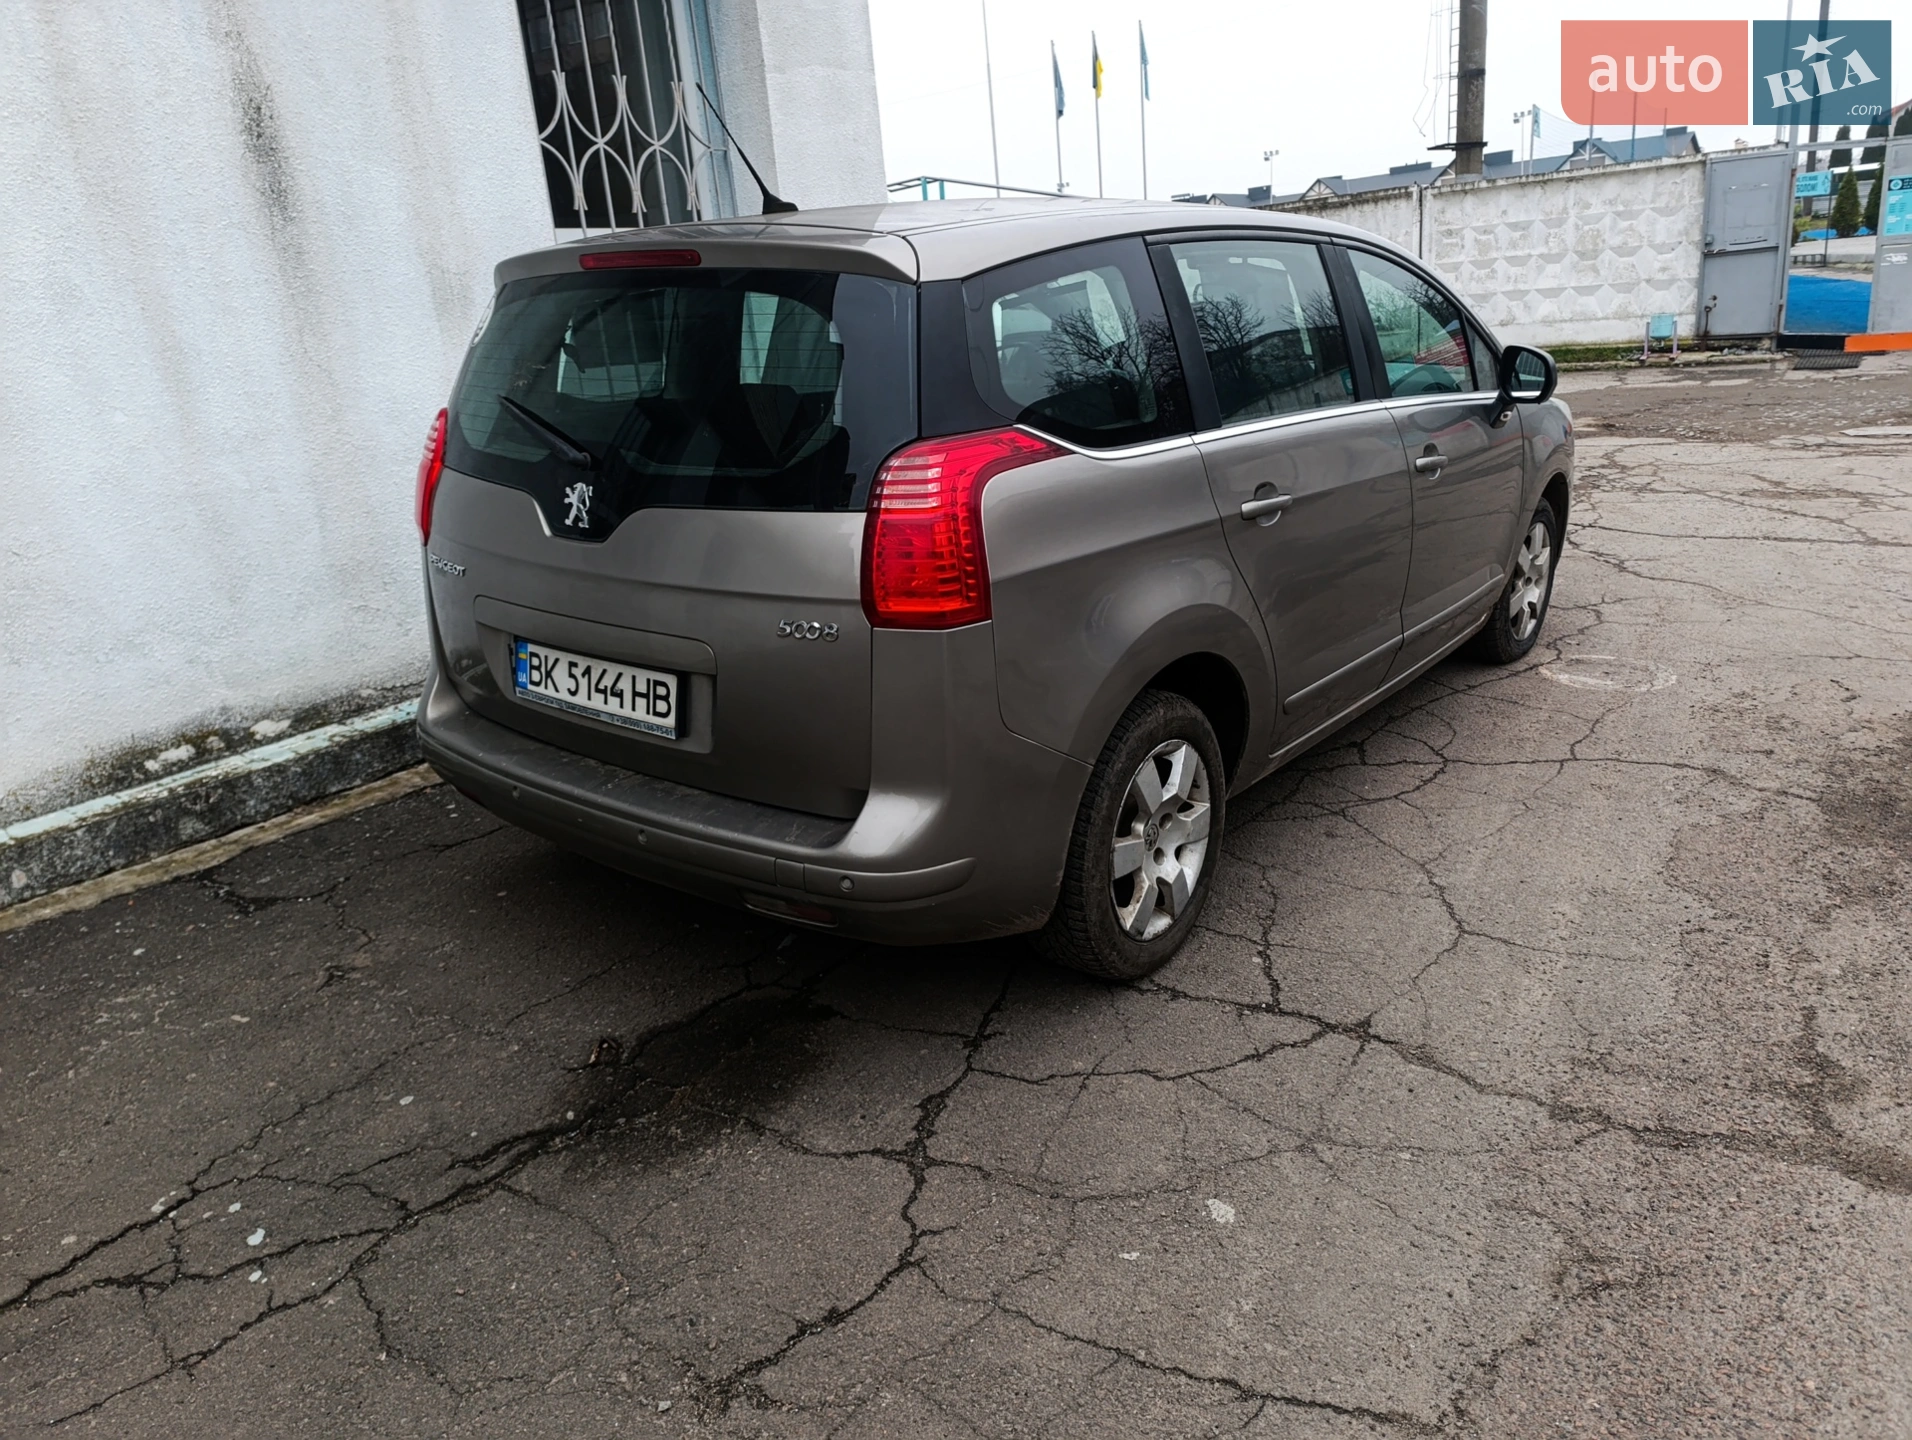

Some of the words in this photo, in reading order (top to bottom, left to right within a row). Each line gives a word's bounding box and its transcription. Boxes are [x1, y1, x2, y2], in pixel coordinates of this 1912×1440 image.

[430, 553, 467, 577] PEUGEOT
[777, 619, 839, 642] 5008
[517, 671, 528, 684] UA
[528, 650, 561, 694] BK
[566, 660, 624, 710] 5144
[631, 674, 672, 719] HB
